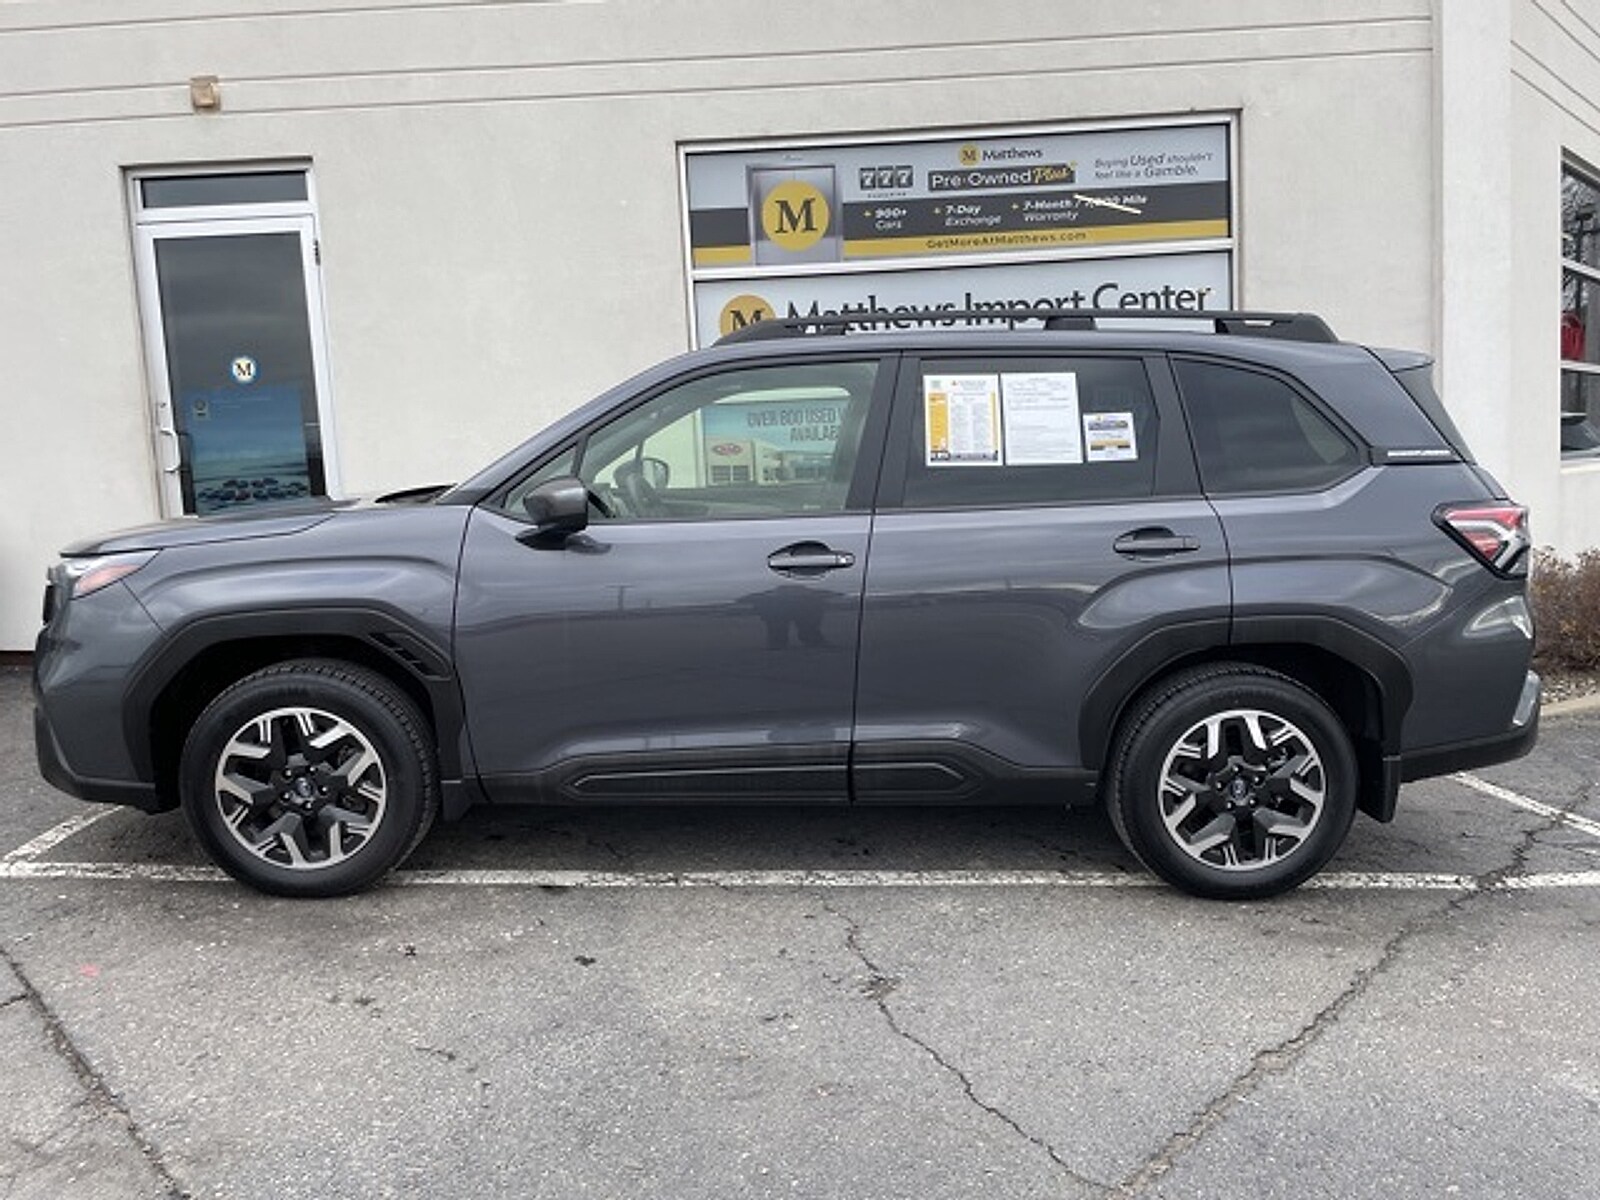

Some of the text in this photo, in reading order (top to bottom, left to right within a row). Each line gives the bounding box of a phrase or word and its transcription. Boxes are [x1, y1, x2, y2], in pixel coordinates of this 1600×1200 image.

[982, 148, 1043, 162] Matthews
[1130, 153, 1166, 167] Used
[775, 197, 818, 234] M
[946, 204, 982, 217] 7-Day
[1024, 210, 1079, 223] Warranty
[875, 219, 902, 230] Cars
[945, 215, 1002, 227] Exchange
[1092, 282, 1208, 312] Center
[747, 410, 779, 428] OVER
[806, 407, 836, 424] USED
